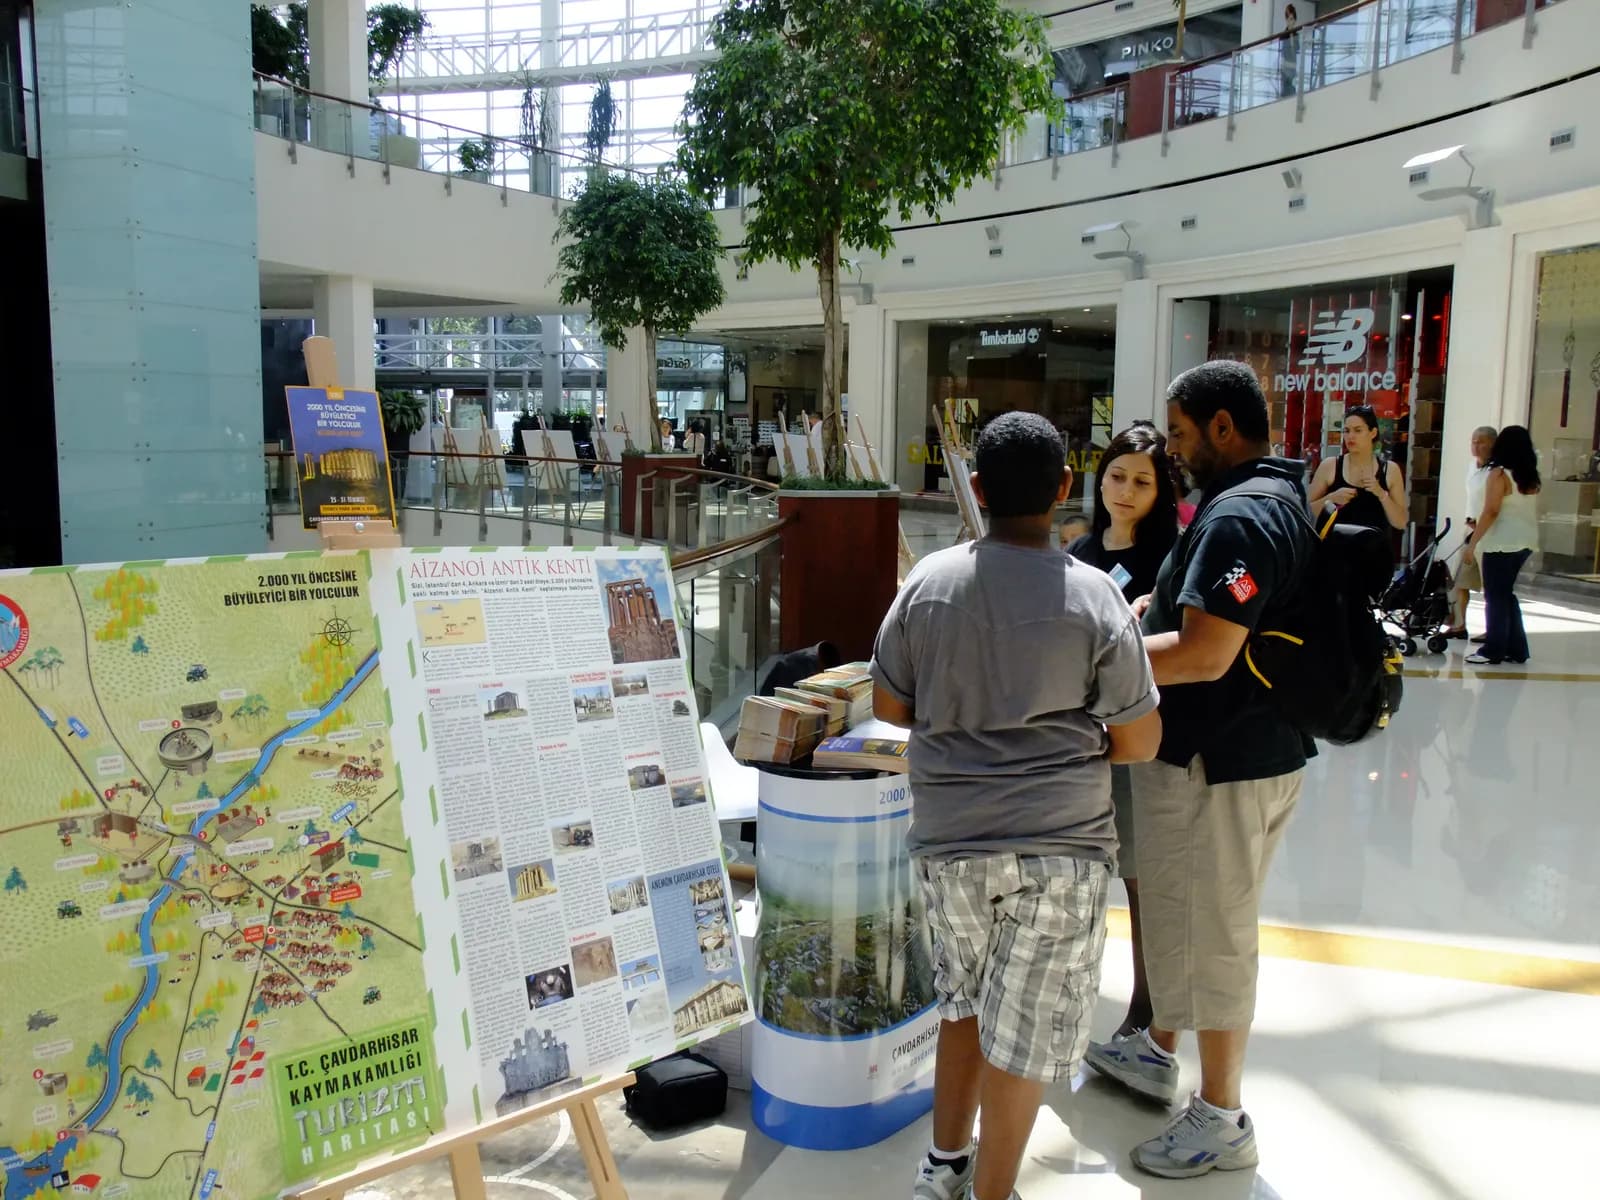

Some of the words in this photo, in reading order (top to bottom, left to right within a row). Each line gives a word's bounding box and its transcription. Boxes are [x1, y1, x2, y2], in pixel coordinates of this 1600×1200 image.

[1121, 36, 1174, 59] PINKO
[979, 327, 1026, 346] Timberland
[1274, 373, 1310, 391] new
[1313, 368, 1396, 391] balance
[907, 443, 943, 465] SAL
[1066, 449, 1104, 473] ALE
[258, 574, 289, 587] 2.000
[291, 573, 307, 585] YIL
[309, 569, 357, 584] ÖNCESİNE
[410, 557, 485, 578] AİZANOİ
[492, 556, 543, 576] ANTİK
[546, 556, 591, 574] KENTİ
[224, 589, 286, 606] BÜYÜLEYİCİ
[288, 588, 307, 601] BİR
[309, 586, 359, 600] YOLCULUK
[879, 787, 905, 805] 2000
[285, 1060, 315, 1081] T.C.
[289, 1049, 422, 1107] KAYMAKAMLIĞI
[294, 1075, 426, 1143] TURİZM
[301, 1106, 430, 1165] HARİTASI
